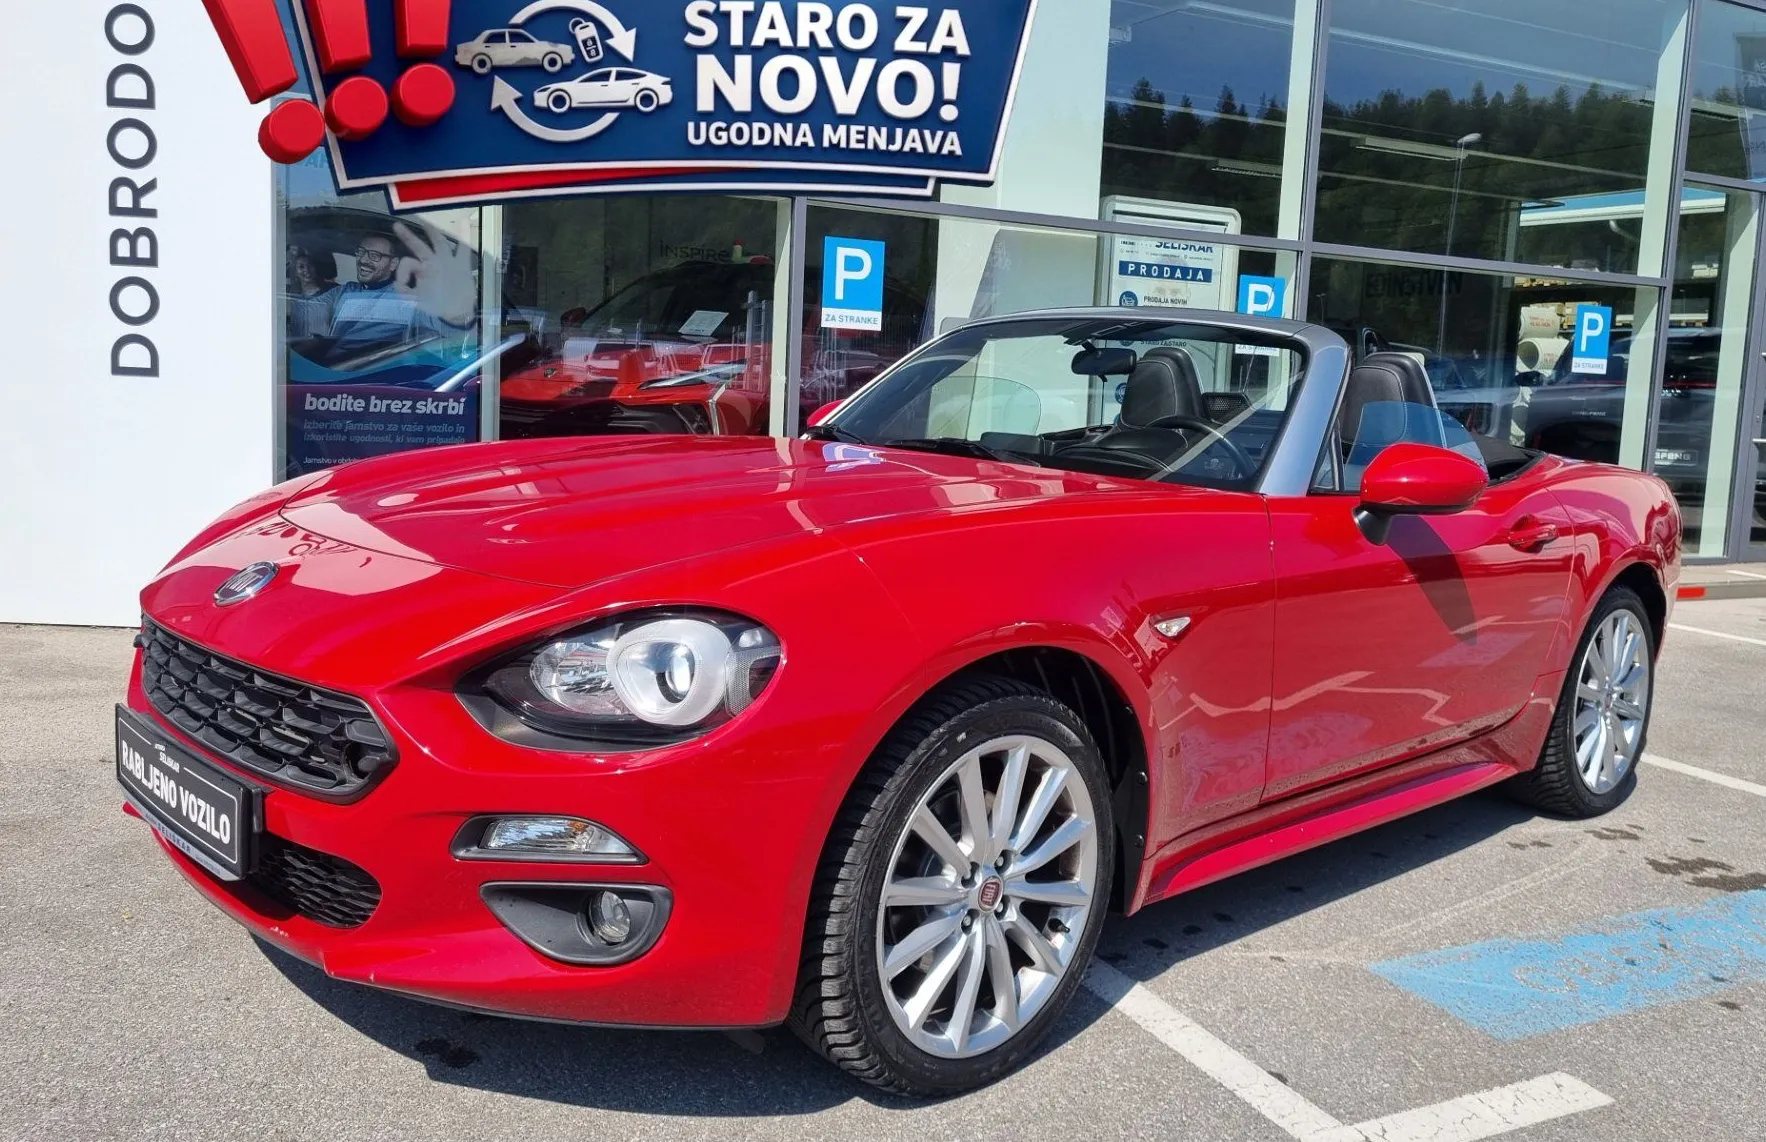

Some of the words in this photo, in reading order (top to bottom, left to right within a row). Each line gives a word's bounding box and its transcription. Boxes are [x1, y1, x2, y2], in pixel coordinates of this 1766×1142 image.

[104, 3, 160, 378] DOBRODO
[835, 246, 872, 300] P
[1127, 263, 1204, 280] PRODAJA
[1143, 295, 1169, 304] PRODAJA
[1246, 283, 1275, 315] P
[825, 313, 837, 322] ZA
[838, 314, 878, 325] STRANKE
[1580, 312, 1604, 352] P
[304, 393, 365, 412] bodite
[369, 396, 412, 413] brez
[415, 398, 466, 415] skrbi
[343, 421, 385, 432] jamstvo
[401, 421, 424, 432] vaše
[427, 424, 454, 433] vozilo
[303, 456, 332, 464] Jamstvo
[122, 740, 177, 809] RABLJENO
[179, 785, 231, 845] VOZILO
